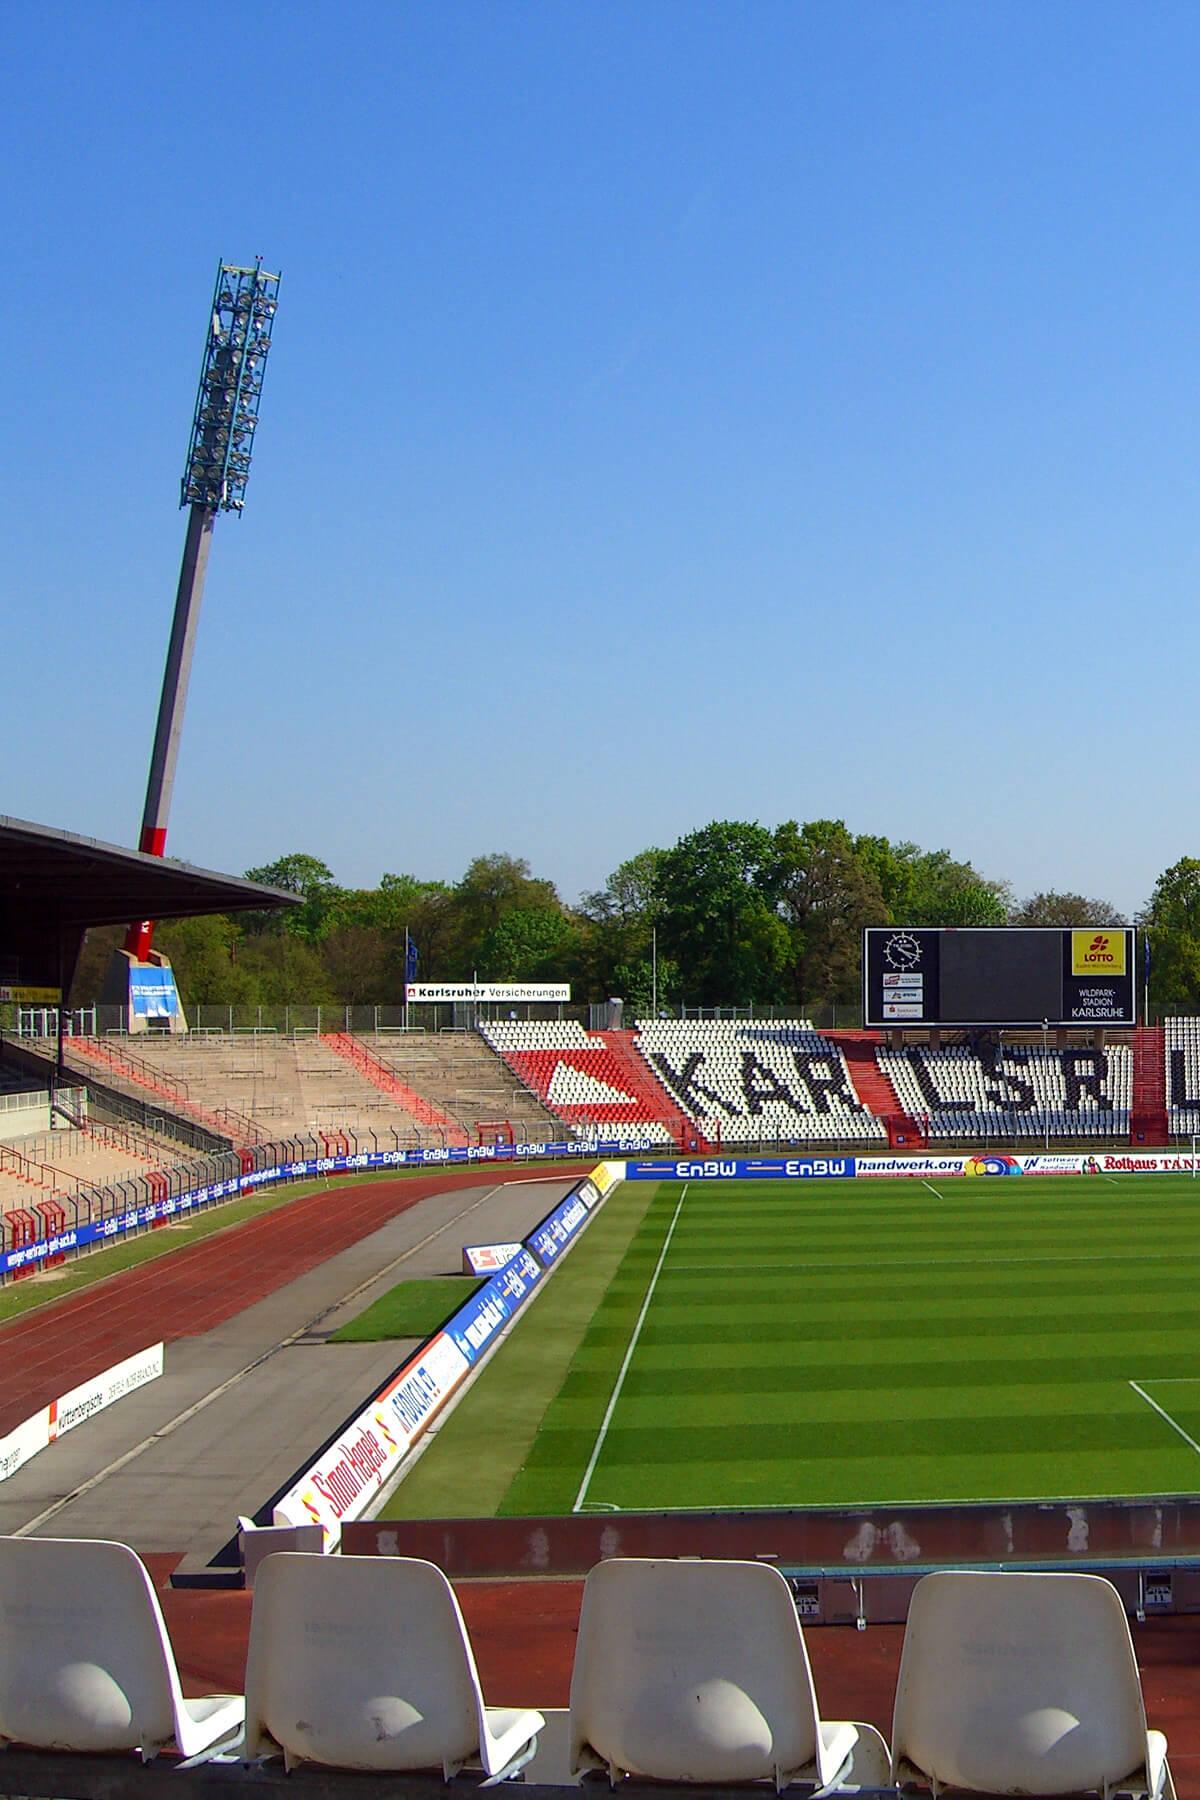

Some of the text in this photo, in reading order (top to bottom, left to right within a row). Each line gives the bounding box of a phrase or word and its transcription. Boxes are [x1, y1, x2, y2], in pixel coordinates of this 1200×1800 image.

[1084, 954, 1113, 962] LOTTO
[419, 989, 567, 999] Karlsruher Versicherungen
[1078, 988, 1116, 998] WILDPARK-
[1082, 998, 1113, 1007] STADION
[1071, 1007, 1125, 1018] KARLSRUHE
[346, 1154, 368, 1166] EnBW
[383, 1151, 405, 1163] EnBW
[423, 1148, 449, 1159] EnBW
[467, 1146, 494, 1157] EnBW
[516, 1143, 545, 1154] EnBW
[567, 1141, 597, 1152] EnBW
[619, 1139, 650, 1150] EnBW
[676, 1160, 846, 1177] EnBW EnBW
[858, 1159, 963, 1171] handwerk.org
[1104, 1155, 1157, 1172] Rothaus
[392, 1377, 433, 1429] FIDUCIA
[310, 1426, 388, 1518] Simon Hegele
